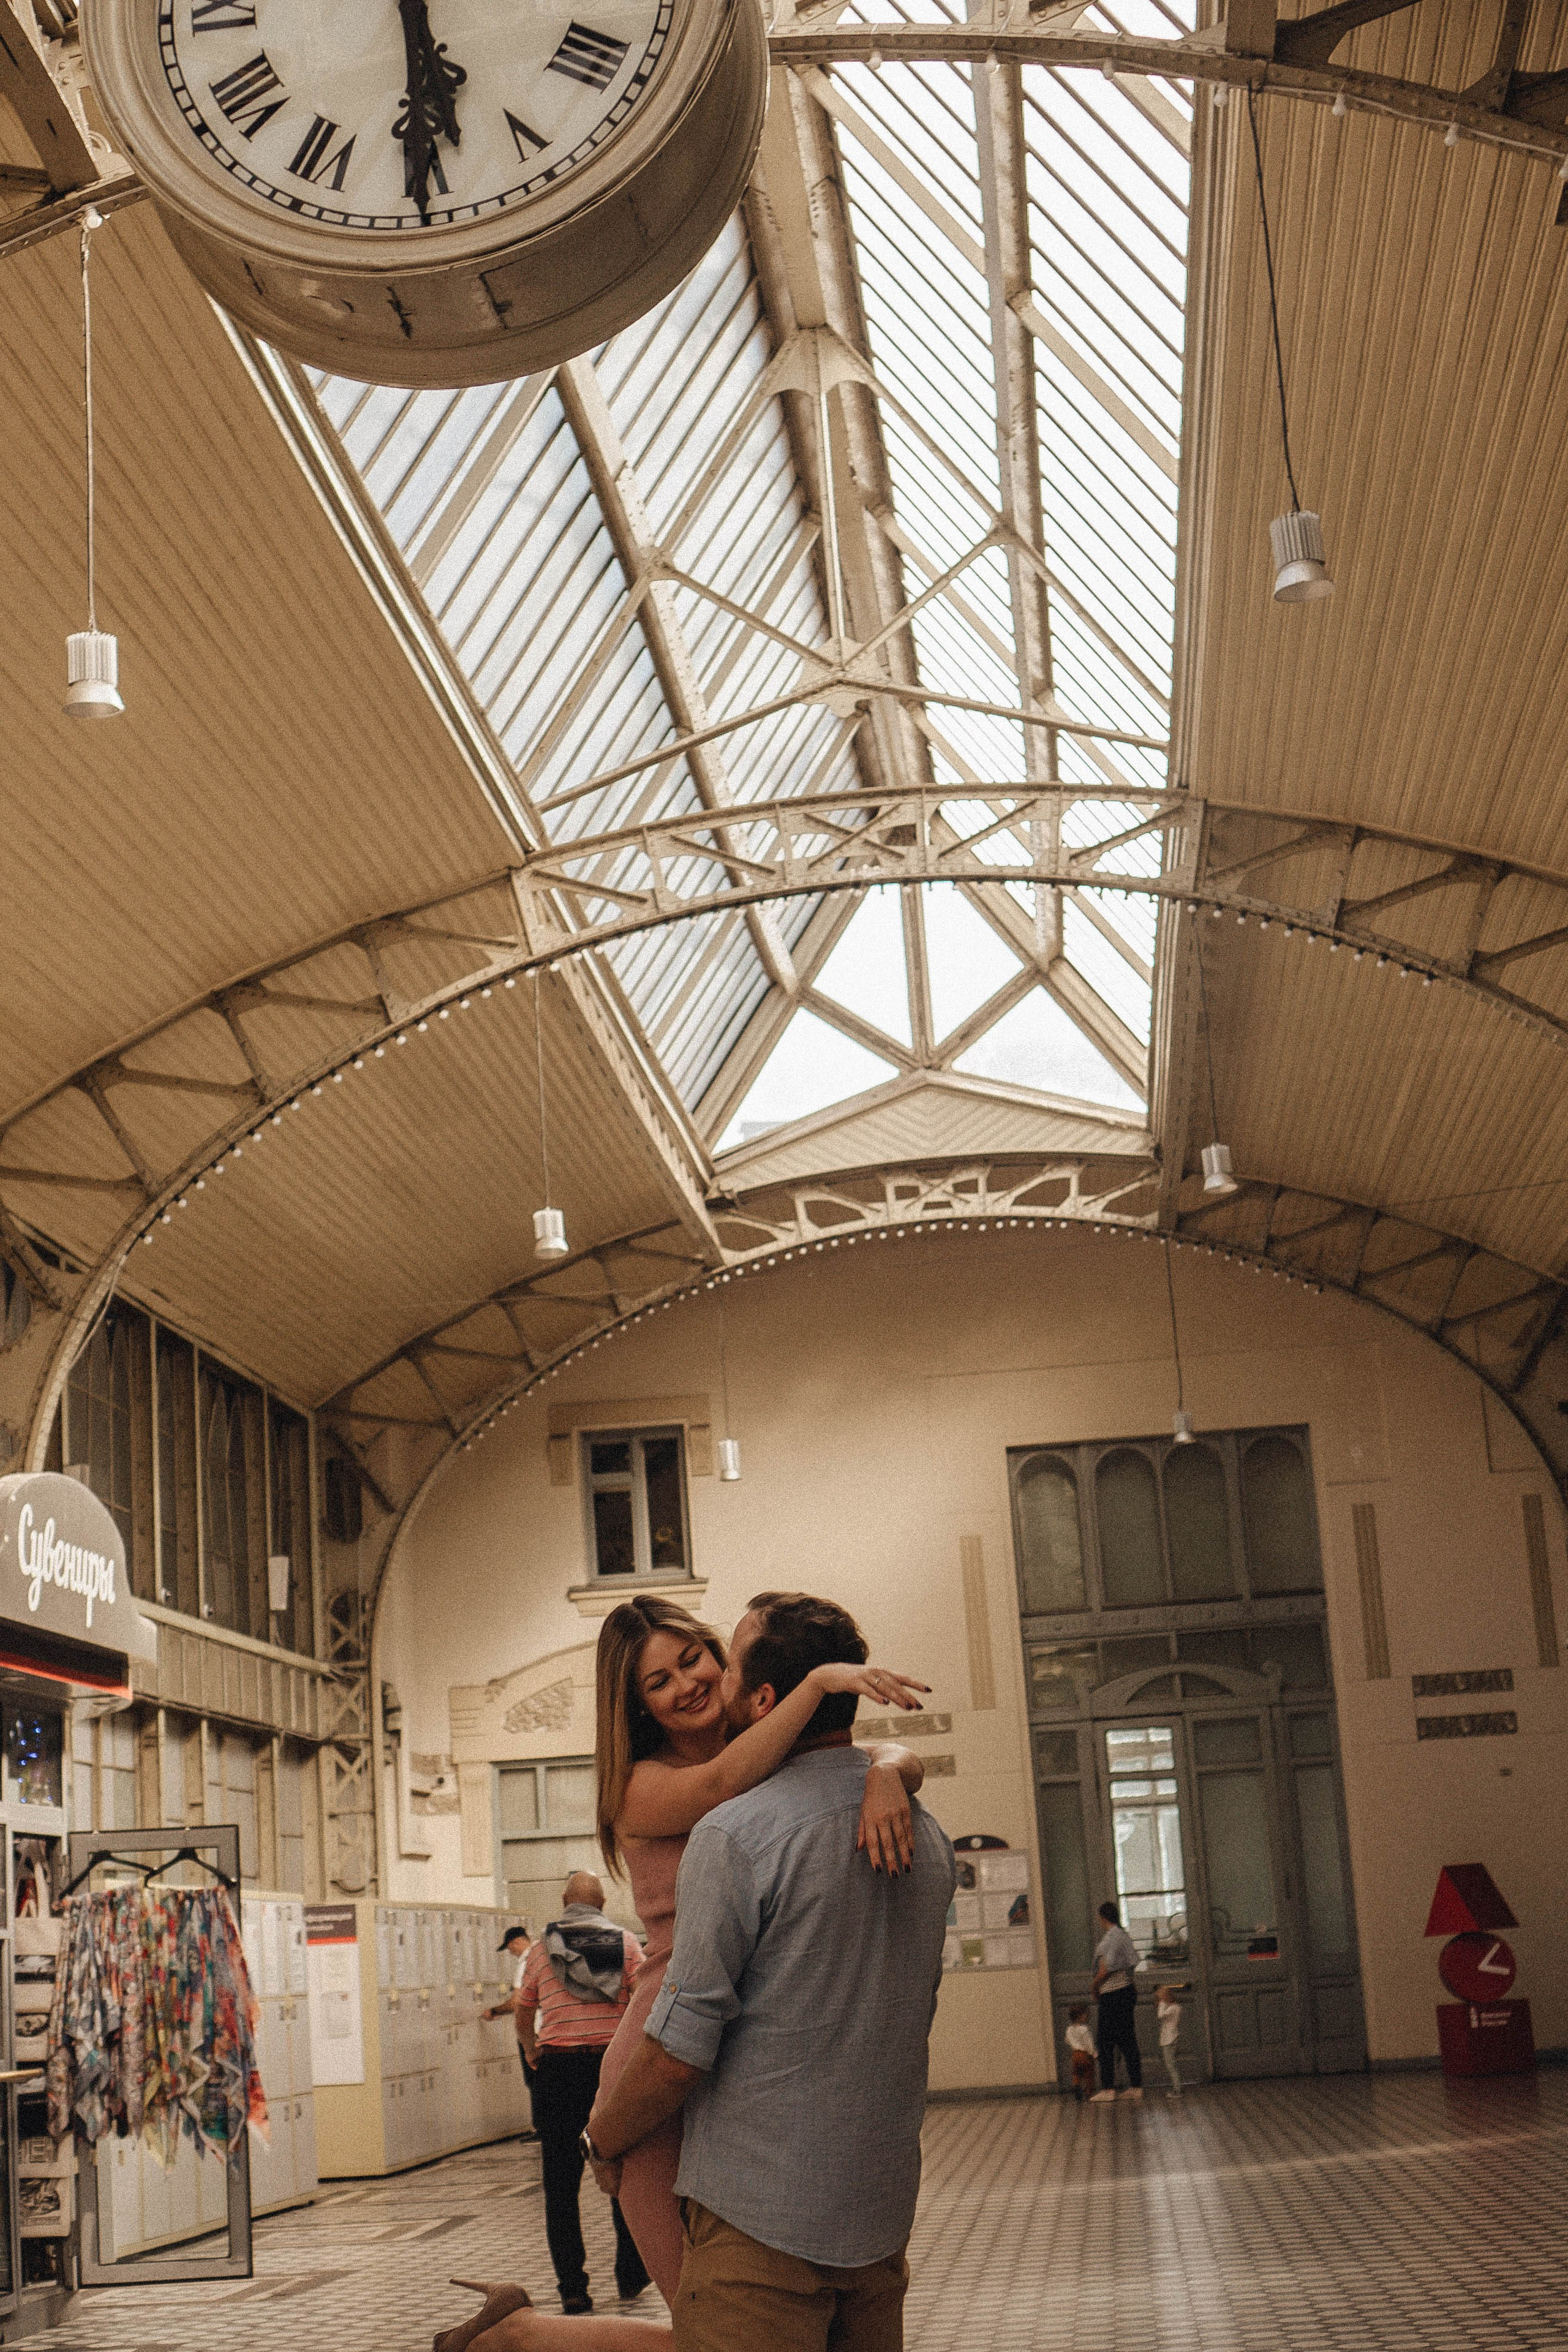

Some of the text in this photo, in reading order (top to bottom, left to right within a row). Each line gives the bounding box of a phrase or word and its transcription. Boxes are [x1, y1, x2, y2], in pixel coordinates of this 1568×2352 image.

[208, 48, 292, 143] VIII
[543, 19, 631, 94] IIII
[284, 112, 358, 193] VII
[503, 108, 553, 164] V
[18, 1503, 116, 1628] Сувениры
